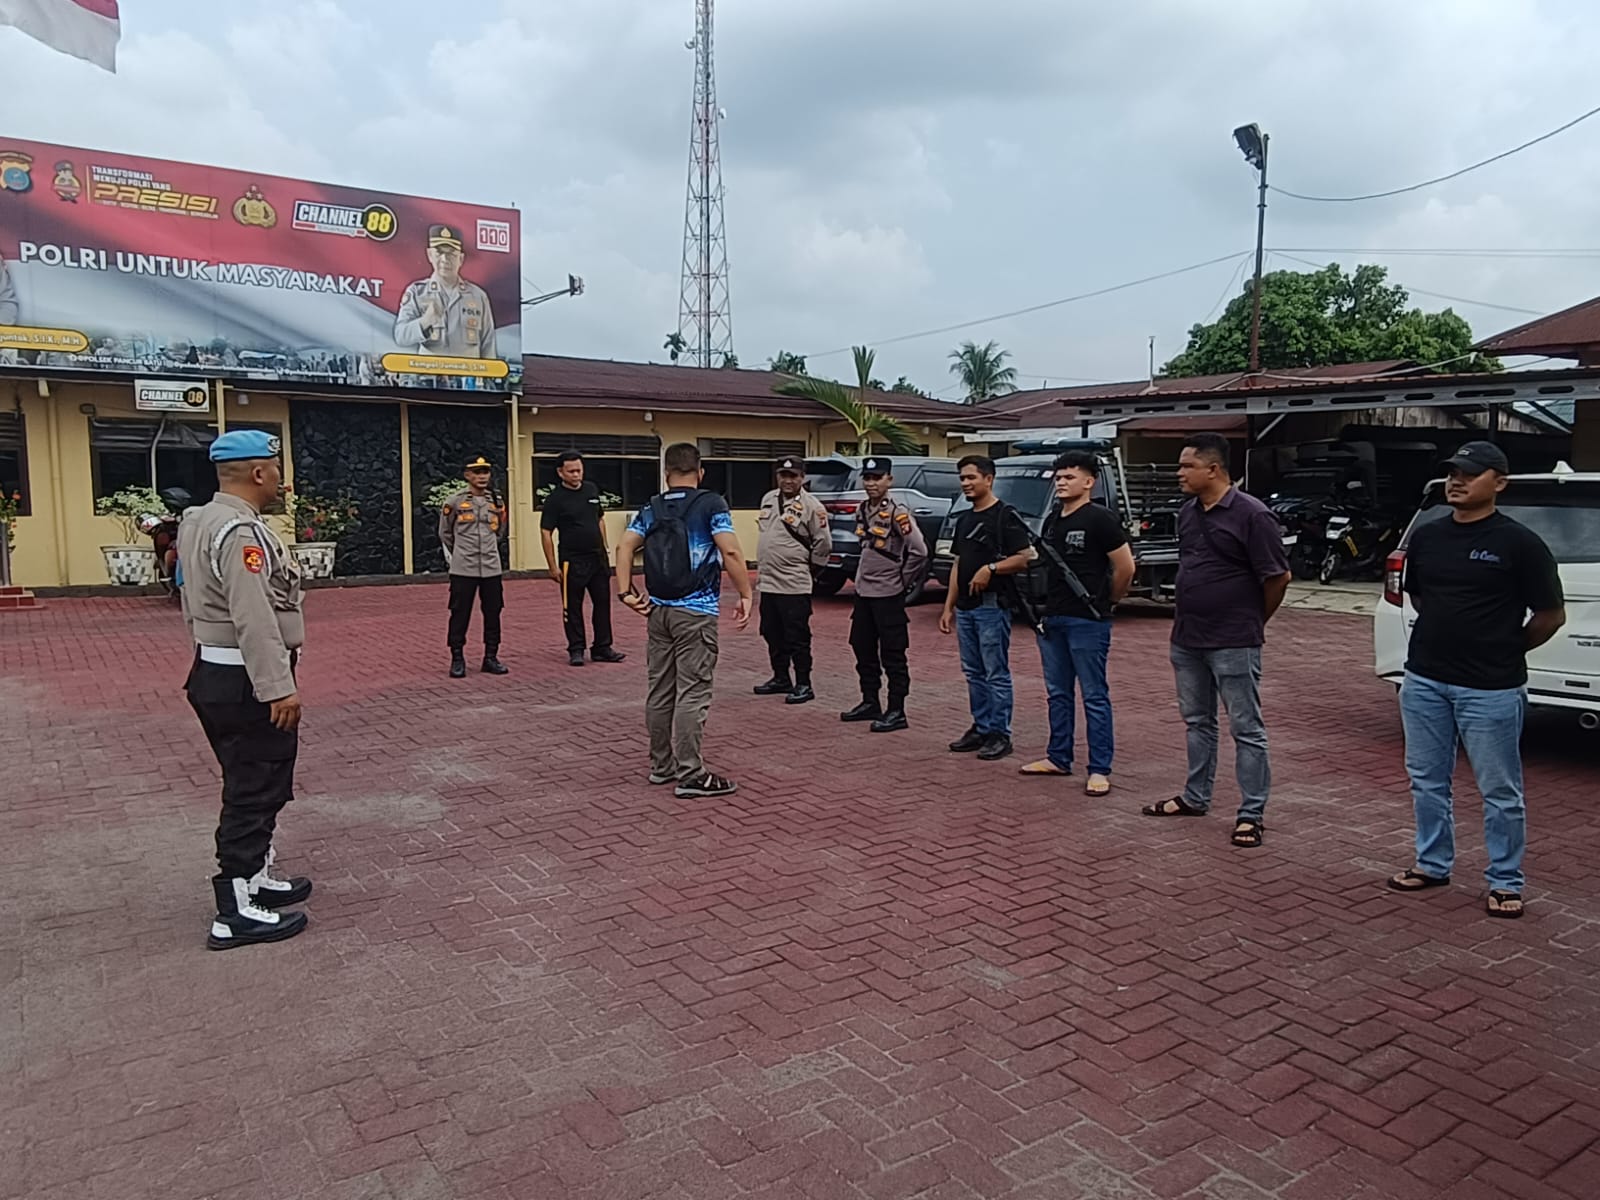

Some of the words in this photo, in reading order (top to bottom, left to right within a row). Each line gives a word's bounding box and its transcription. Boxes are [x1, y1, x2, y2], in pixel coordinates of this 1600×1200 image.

[94, 183, 217, 212] PRESISI
[298, 204, 364, 228] CHANNEL
[366, 211, 392, 233] 88
[480, 228, 507, 246] 110
[19, 241, 108, 271] POLRI
[116, 251, 211, 282] UNTUK
[216, 262, 384, 298] MASYARAKAT
[141, 389, 185, 401] CHANNEL
